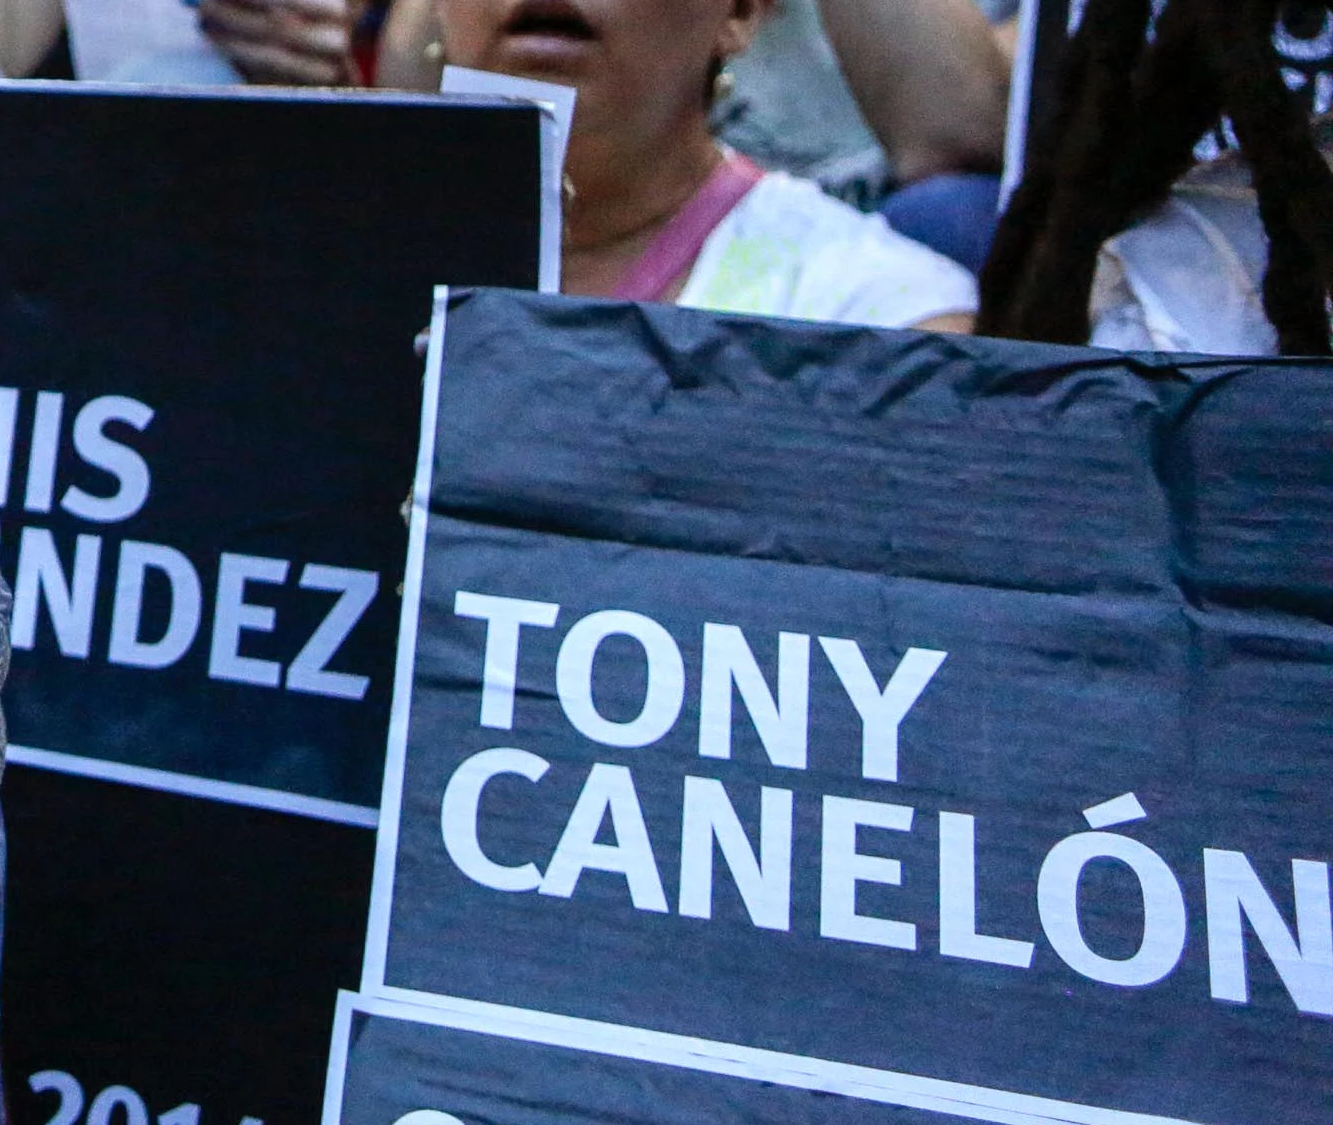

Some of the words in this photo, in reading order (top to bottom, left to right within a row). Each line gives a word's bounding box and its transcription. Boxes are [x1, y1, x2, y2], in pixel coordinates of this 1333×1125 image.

[10, 527, 380, 702] NDEZ
[454, 590, 949, 784] TONY
[440, 747, 1333, 1017] CANELÓN
